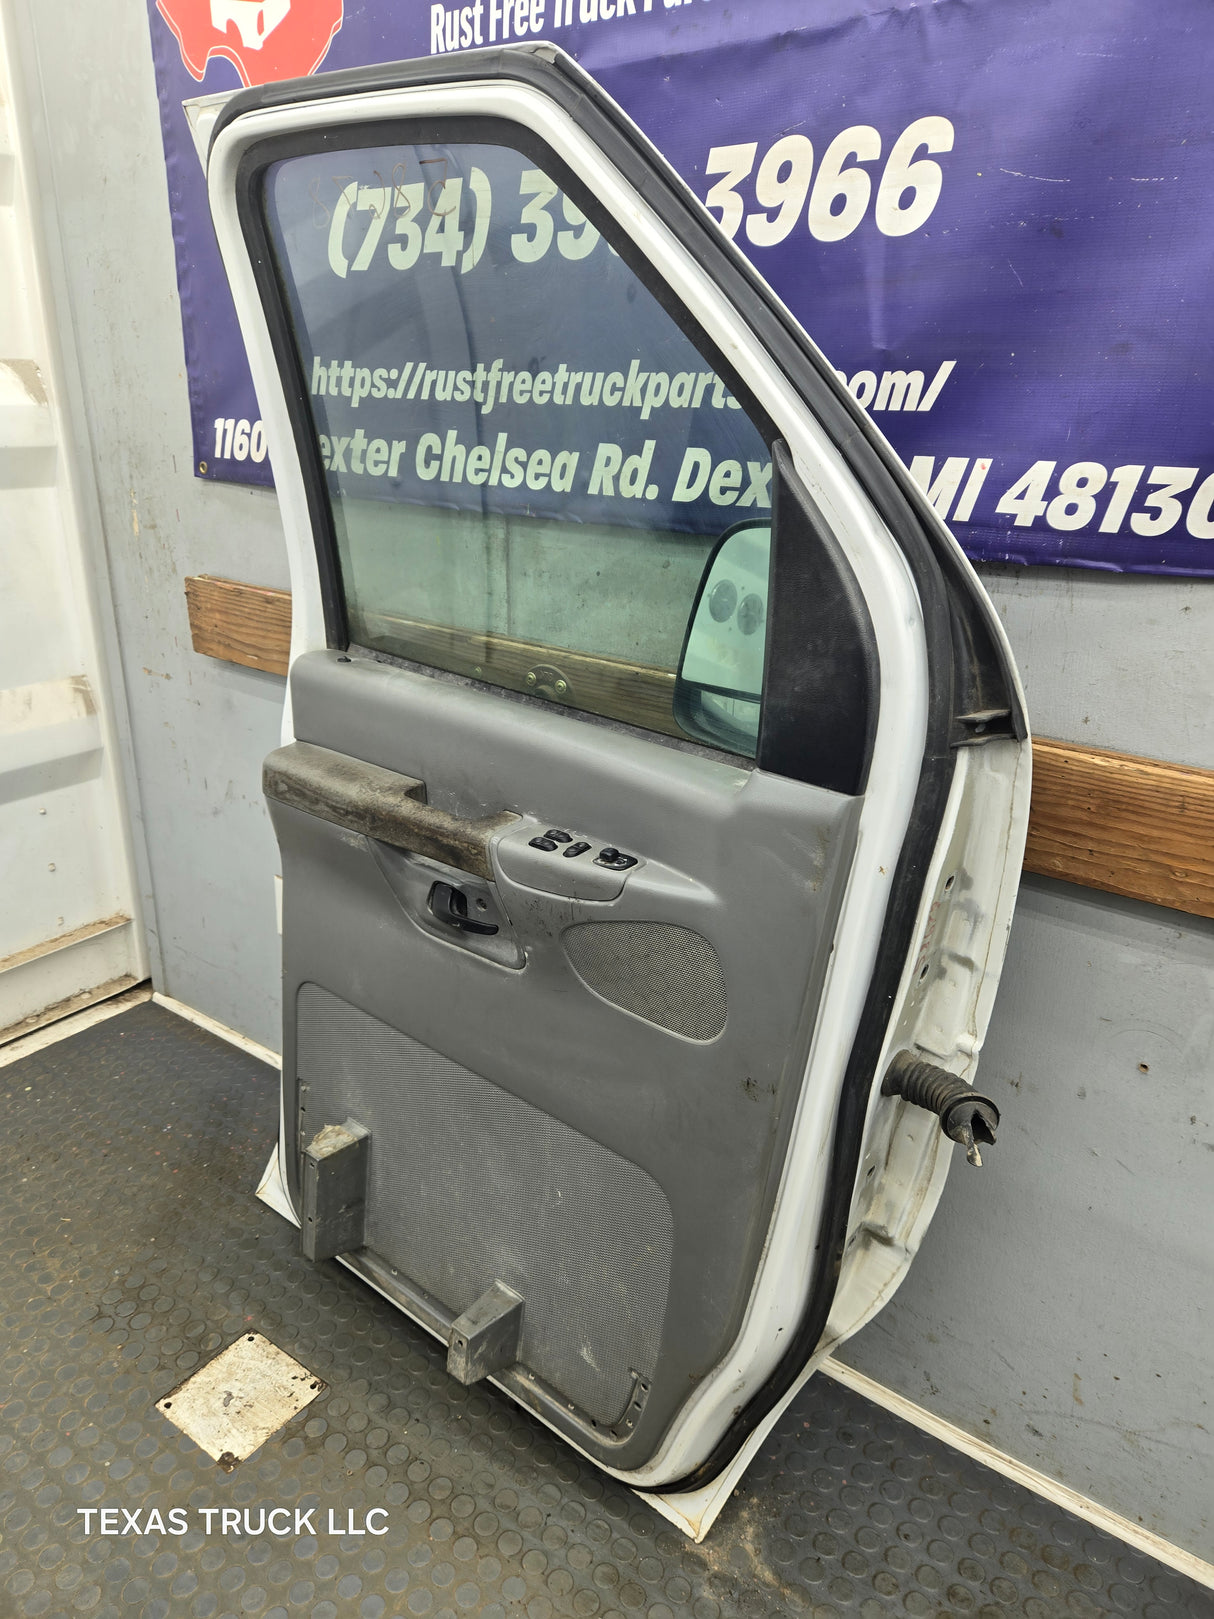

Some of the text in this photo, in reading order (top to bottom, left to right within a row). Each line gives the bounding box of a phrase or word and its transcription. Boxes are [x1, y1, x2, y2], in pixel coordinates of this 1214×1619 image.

[430, 2, 484, 54] Rust
[489, 0, 546, 42] Free
[328, 116, 955, 279] (734) 39 3966
[835, 361, 957, 411] om/
[415, 430, 580, 494] Chelsea
[587, 440, 659, 500] Rd.
[672, 447, 772, 508] Dex
[909, 455, 993, 522] MI
